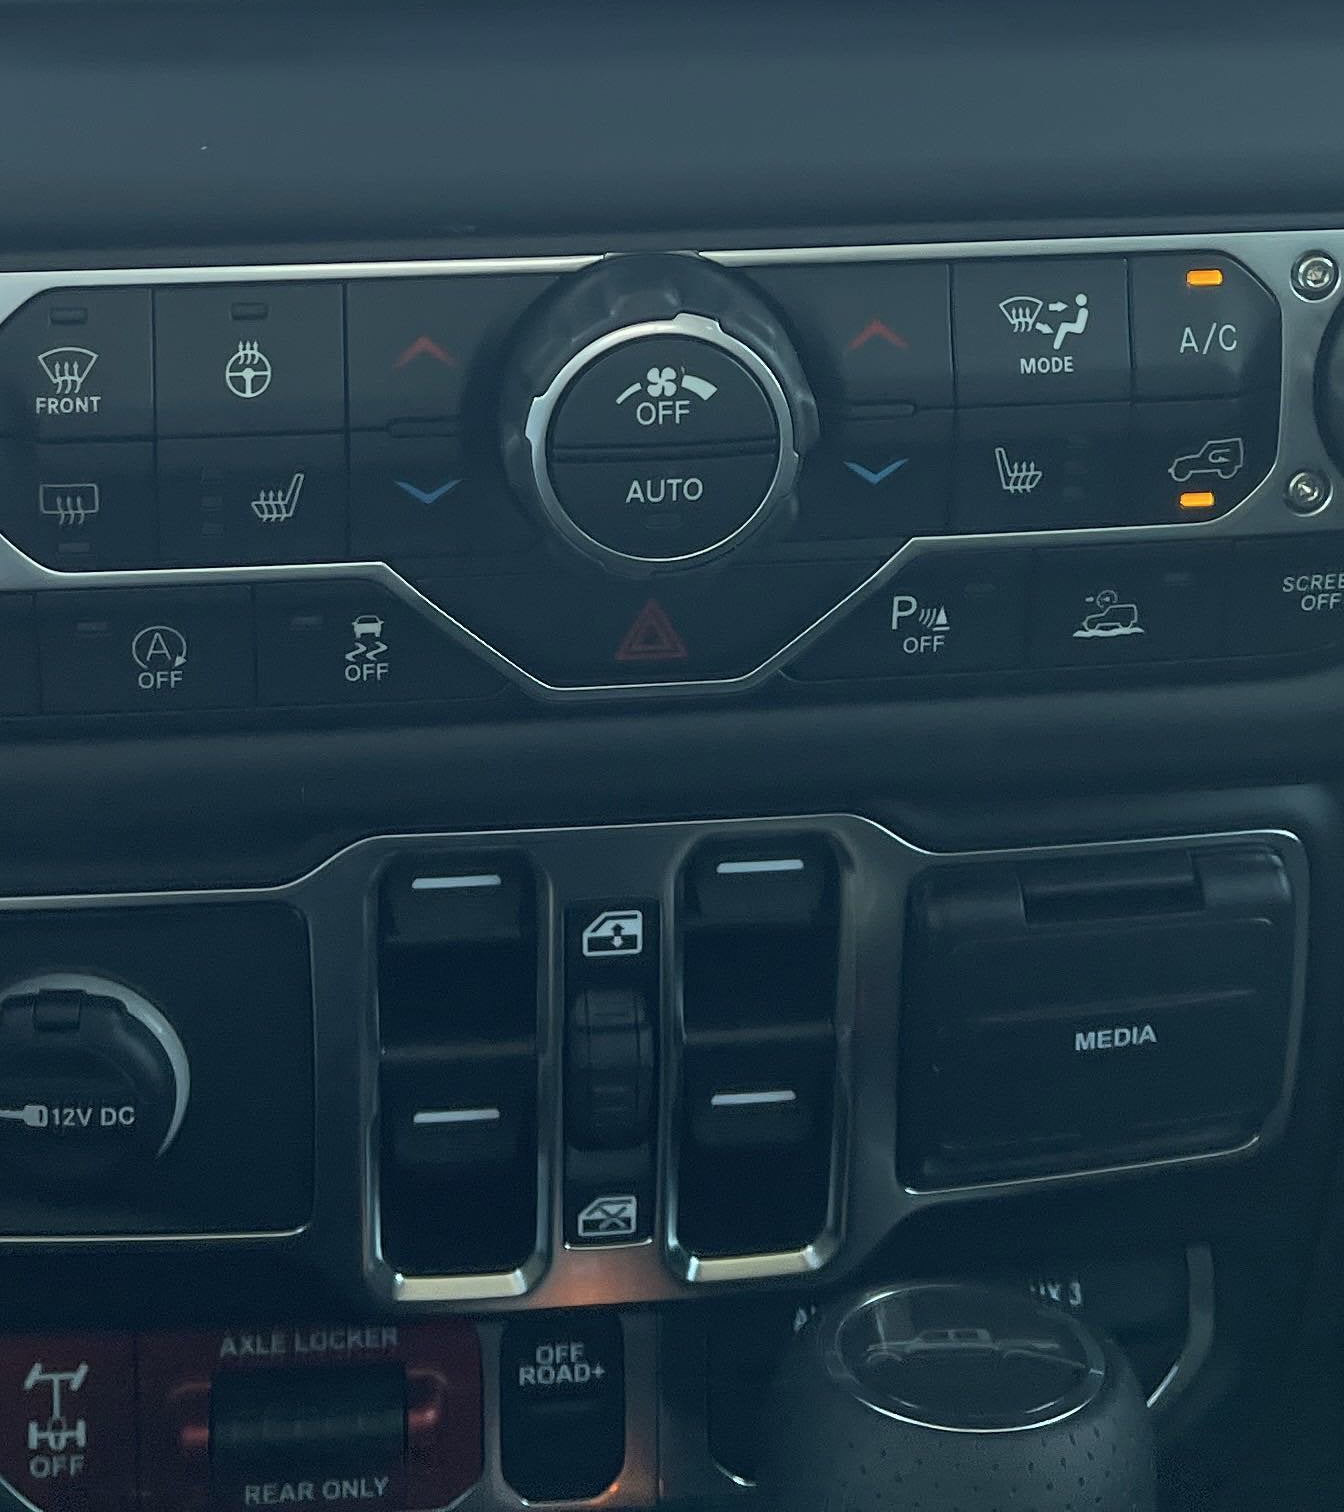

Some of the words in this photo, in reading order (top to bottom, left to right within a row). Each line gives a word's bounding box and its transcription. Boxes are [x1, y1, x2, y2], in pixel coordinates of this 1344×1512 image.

[1179, 324, 1238, 354] A/C
[1020, 356, 1074, 375] MODE
[35, 396, 101, 415] FRONT
[636, 401, 691, 427] OFF
[625, 478, 704, 504] AUTO
[1300, 593, 1343, 612] OFF
[903, 635, 945, 655] OFF
[137, 671, 183, 690] OFF
[344, 663, 389, 683] OFF
[1074, 1024, 1157, 1052] MEDIA
[51, 1106, 93, 1127] 12V
[100, 1106, 135, 1127] DC
[219, 1332, 286, 1358] AXLE
[295, 1327, 398, 1352] LOCKER
[535, 1344, 584, 1365] OFF
[29, 1456, 85, 1479] OFF
[244, 1482, 313, 1505] REAR
[321, 1478, 388, 1502] ONLY
